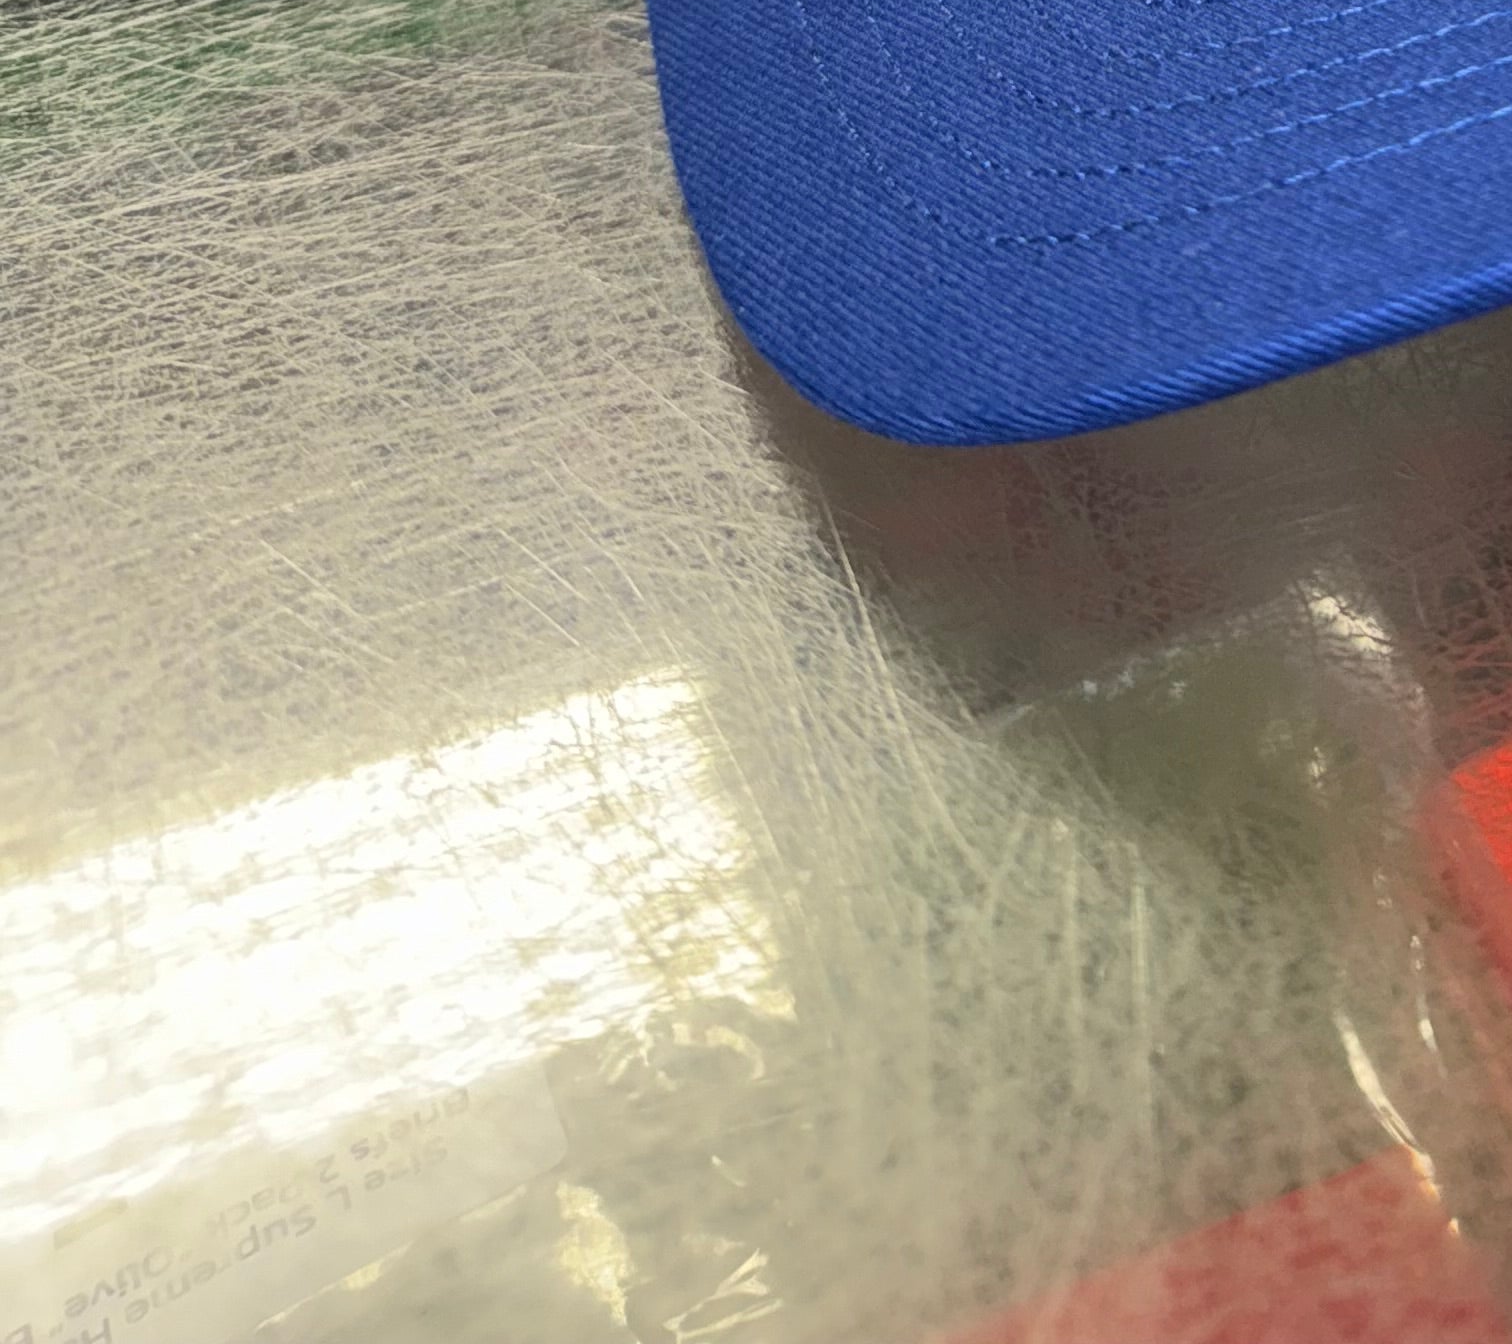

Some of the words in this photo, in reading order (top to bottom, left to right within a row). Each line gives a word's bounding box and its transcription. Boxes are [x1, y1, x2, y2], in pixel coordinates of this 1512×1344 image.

[319, 1153, 341, 1184] 2
[325, 1184, 353, 1212] L
[124, 1202, 318, 1324] Supreme
